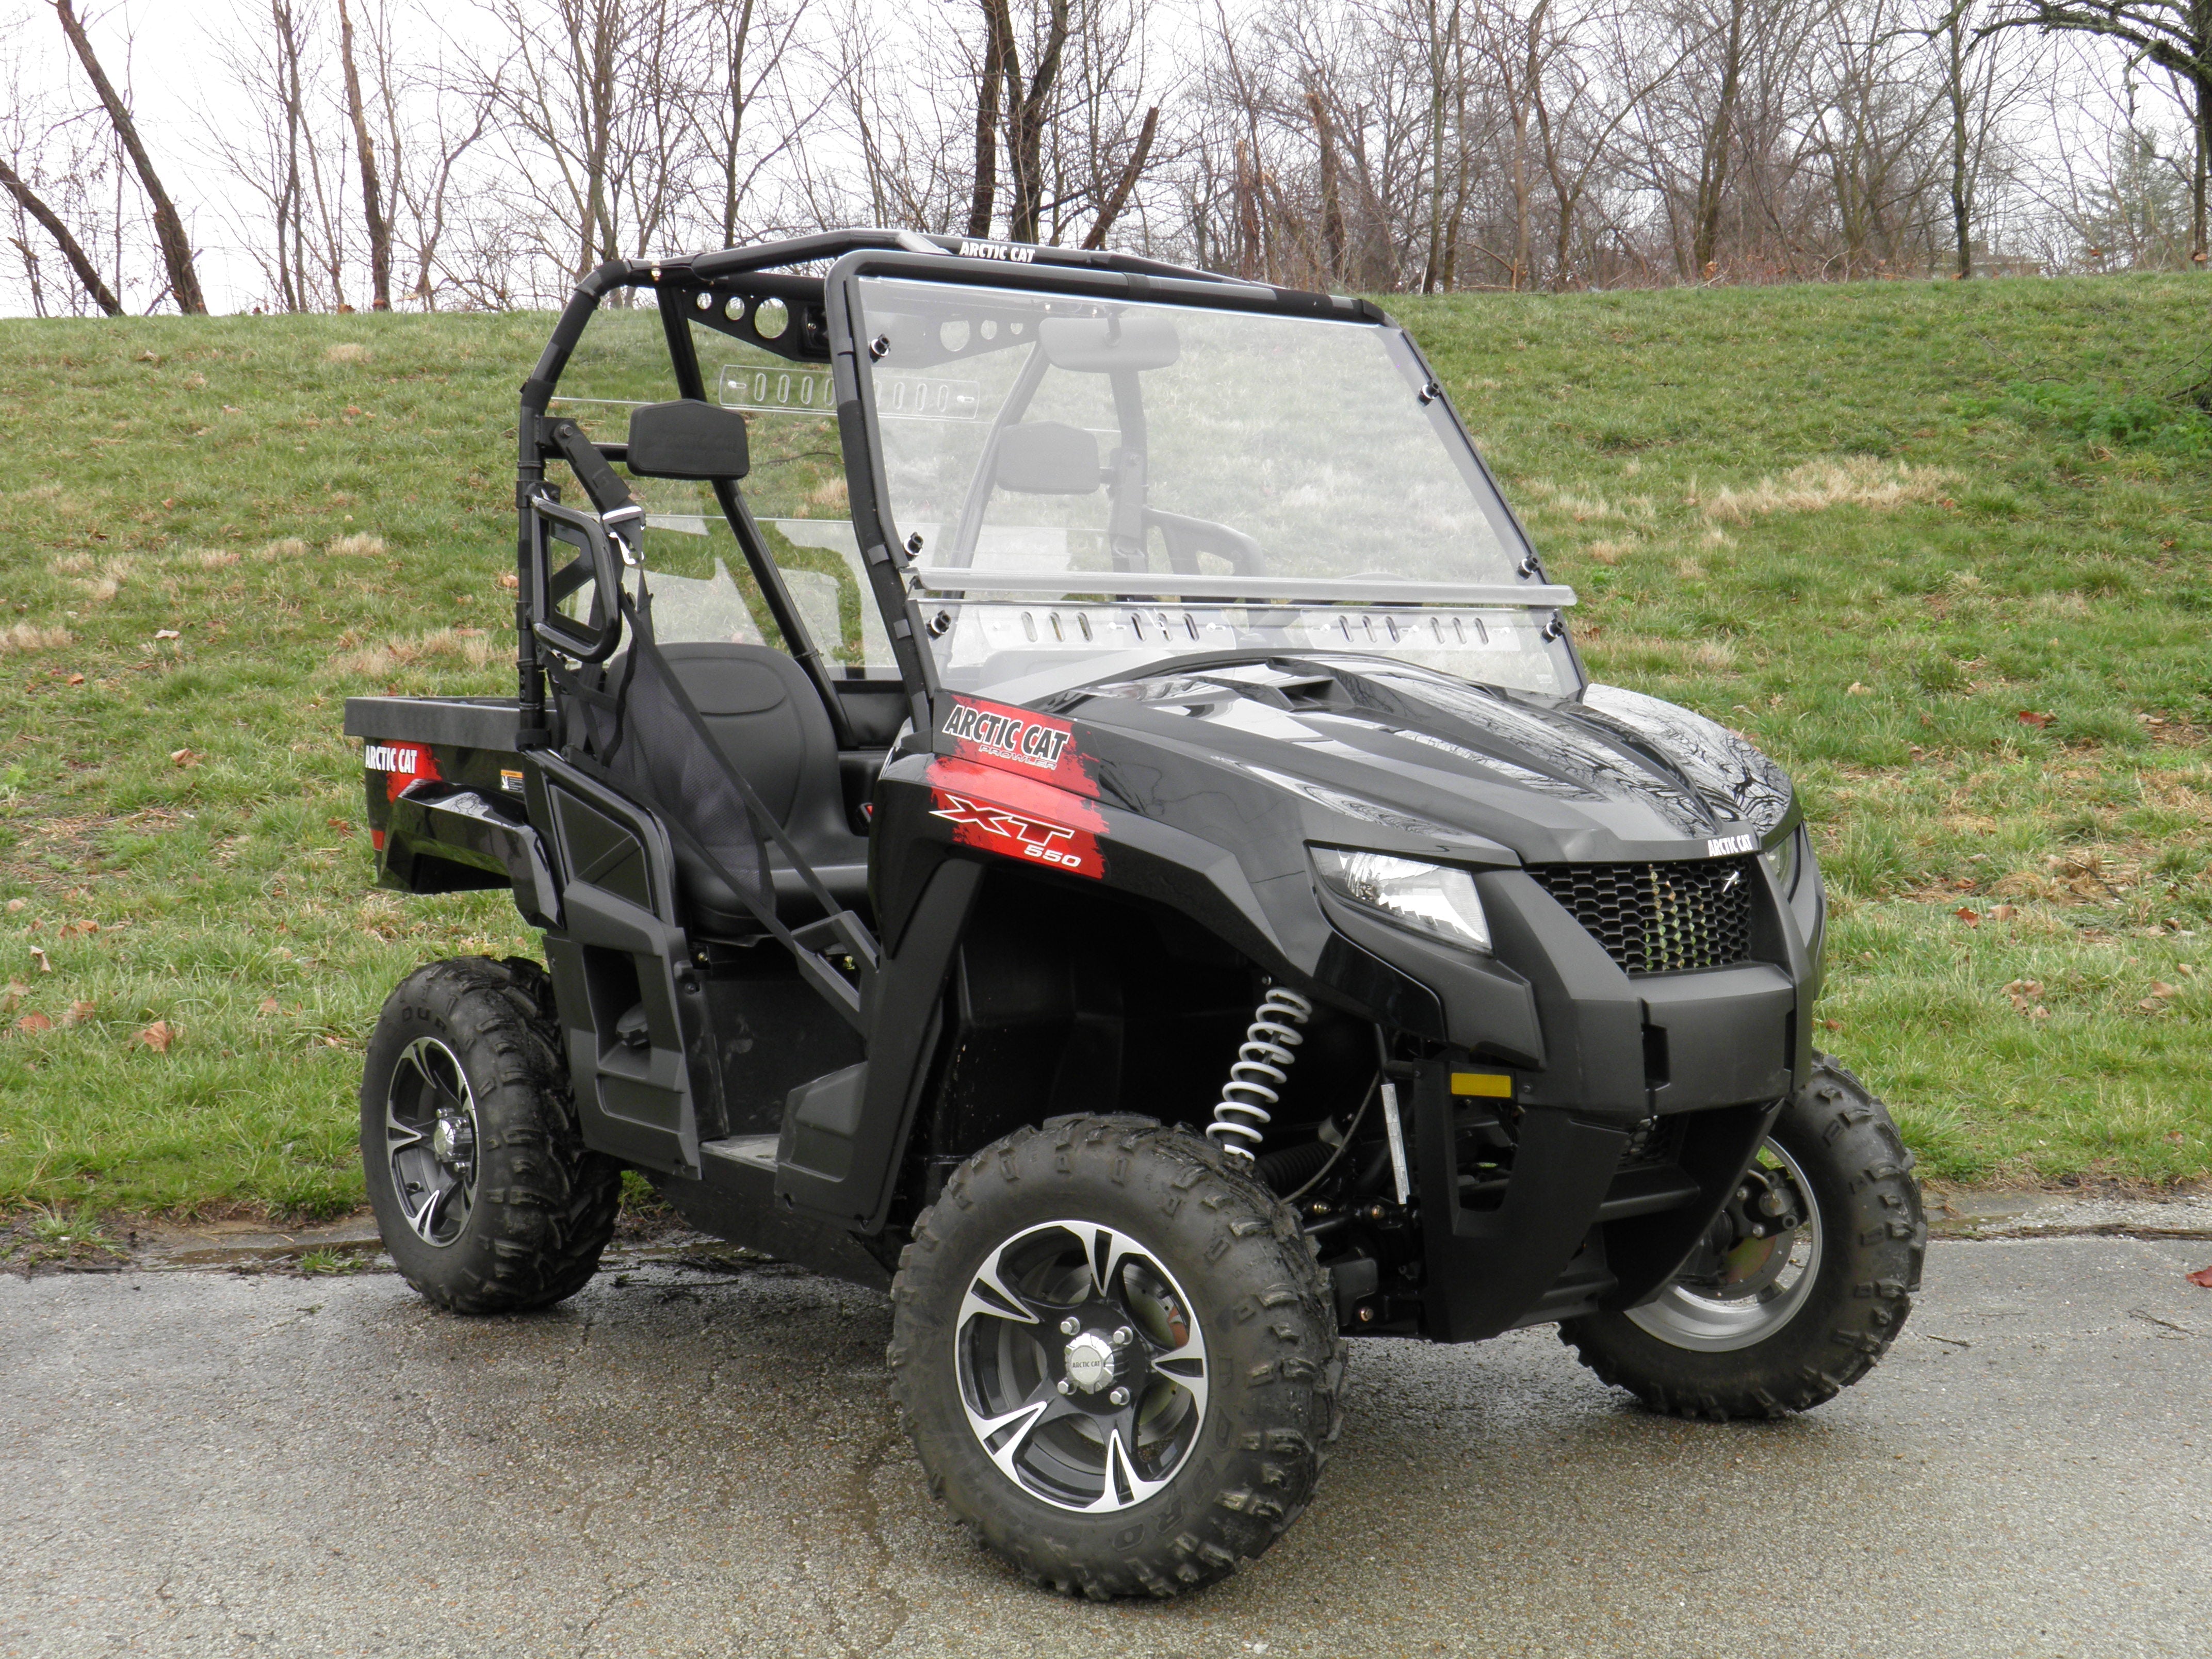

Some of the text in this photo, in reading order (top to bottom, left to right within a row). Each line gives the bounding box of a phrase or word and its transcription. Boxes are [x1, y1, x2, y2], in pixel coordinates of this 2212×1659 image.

[959, 241, 1035, 263] ARCTIC CAT
[942, 704, 1070, 762] ARCTIC CAT
[365, 745, 417, 774] ARCTIC CAT
[979, 745, 1056, 770] PROWLER
[929, 793, 1075, 847] XT
[1024, 844, 1081, 867] 550
[1707, 834, 1753, 857] ARCTIC CAT
